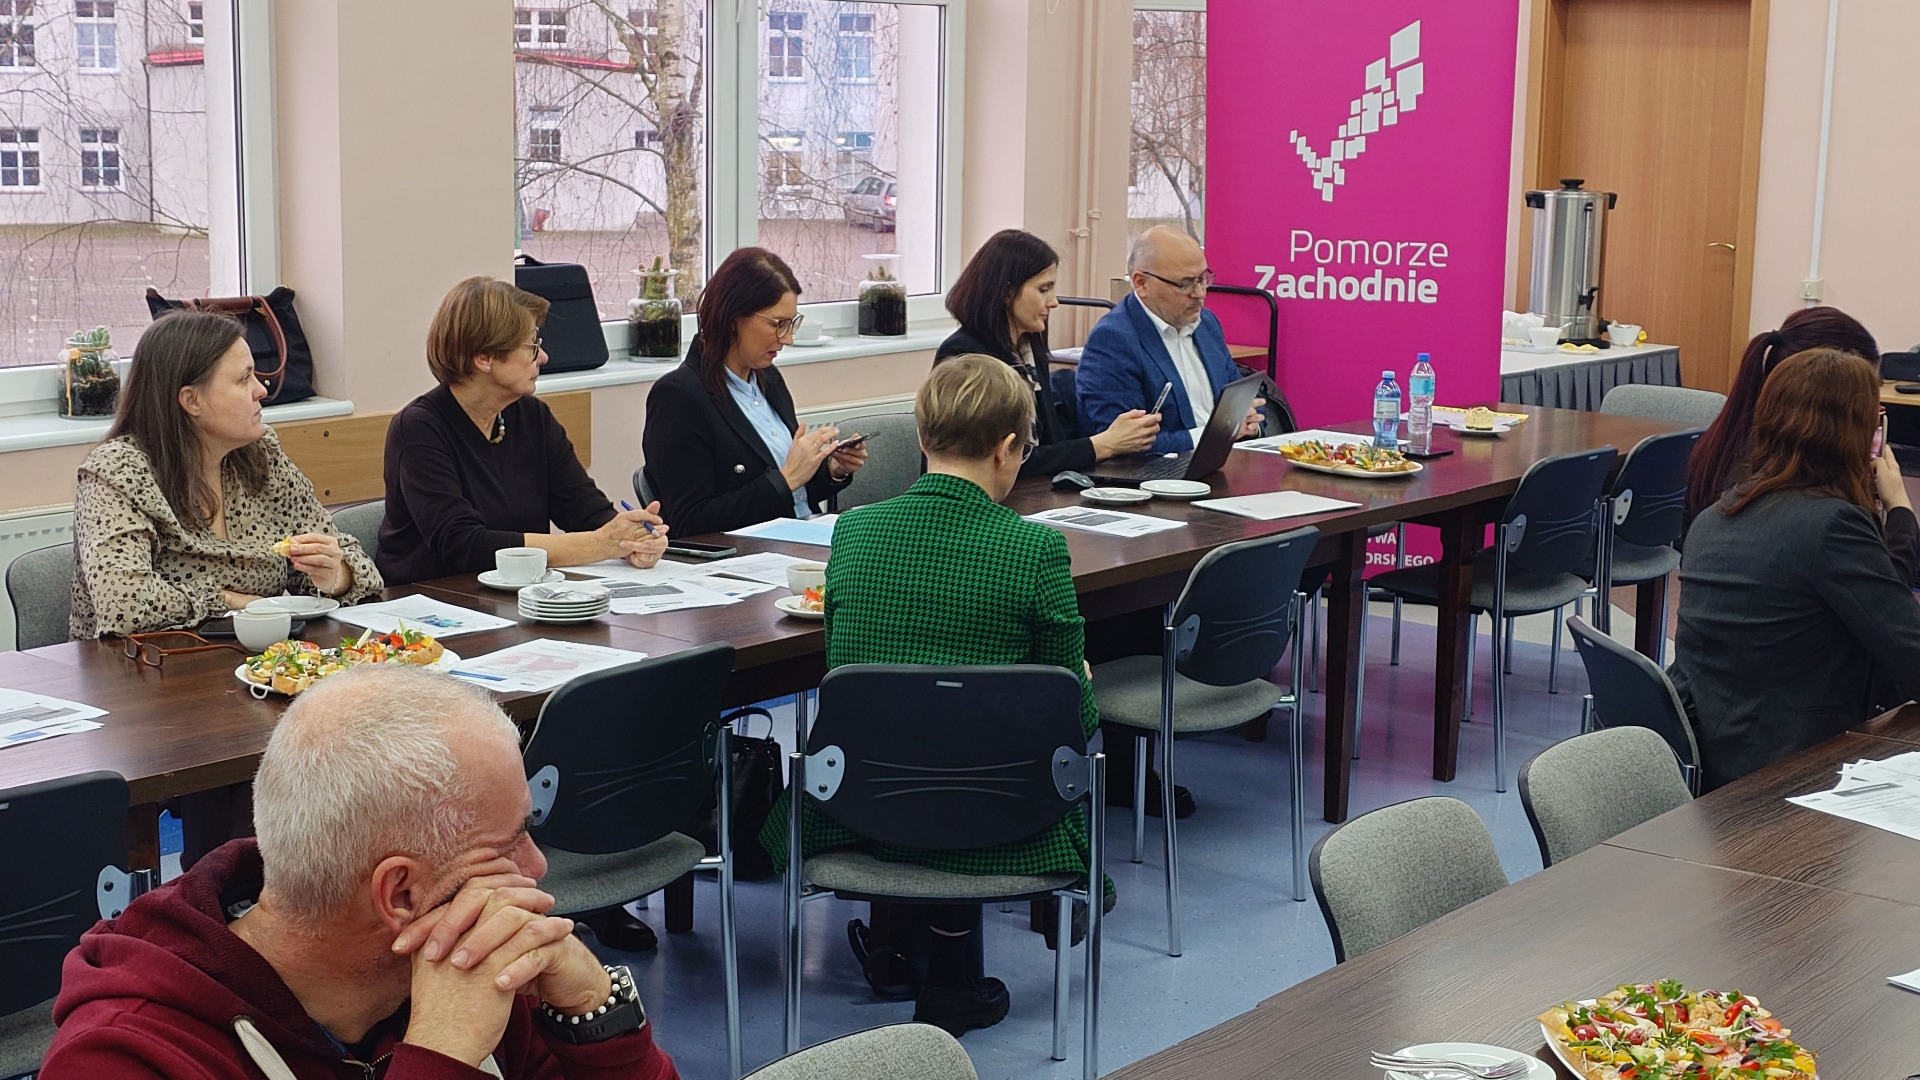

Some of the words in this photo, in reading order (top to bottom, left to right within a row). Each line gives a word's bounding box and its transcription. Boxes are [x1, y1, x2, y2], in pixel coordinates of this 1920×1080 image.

[1290, 229, 1449, 268] Pomorze
[1254, 265, 1438, 303] Zachodnie
[1367, 532, 1397, 545] WA
